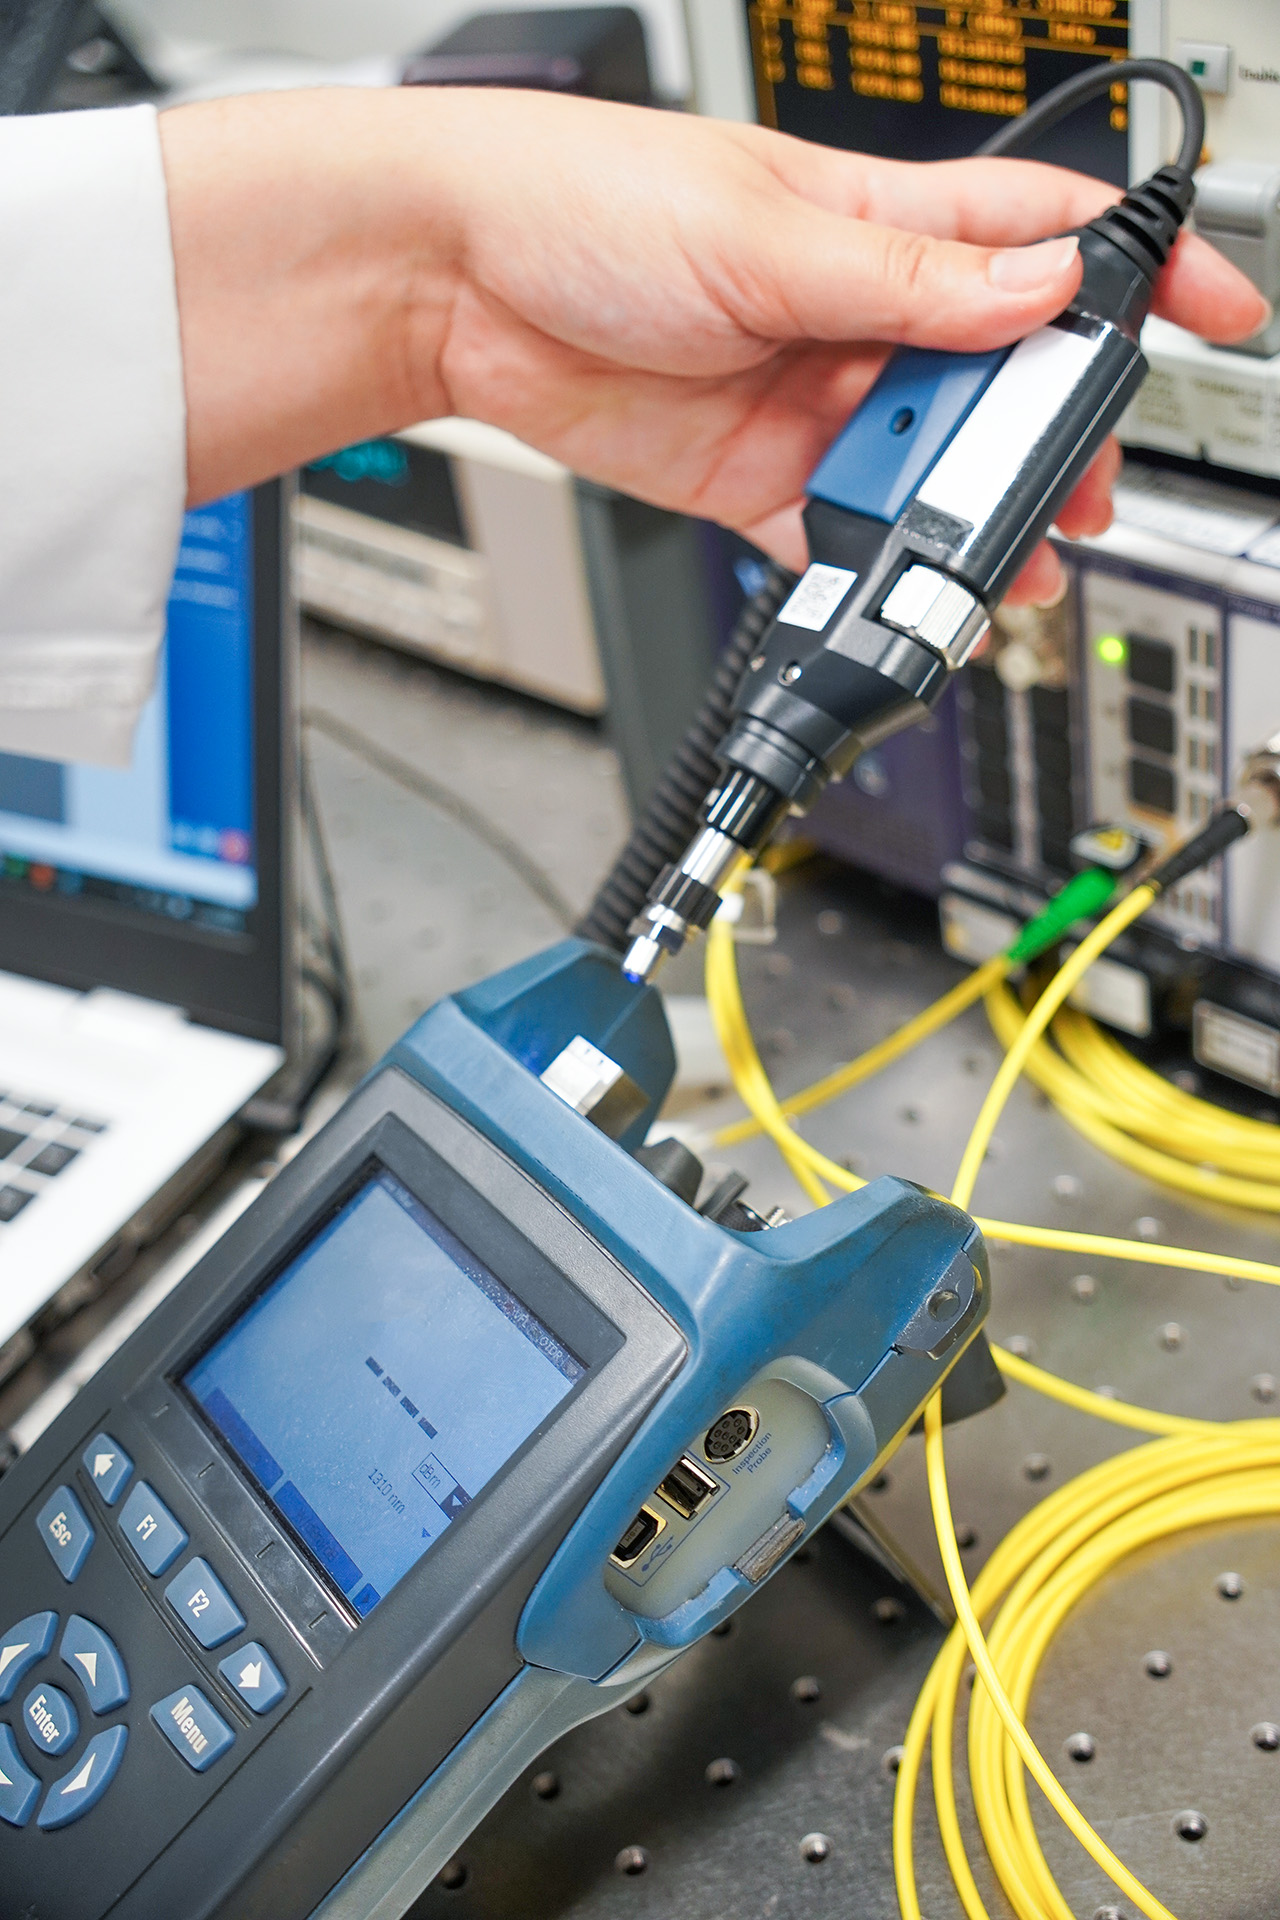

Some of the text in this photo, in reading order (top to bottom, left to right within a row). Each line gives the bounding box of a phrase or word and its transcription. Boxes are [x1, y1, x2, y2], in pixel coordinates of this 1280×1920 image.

[731, 1432, 772, 1475] Inspection
[747, 1447, 772, 1473] Probe
[368, 1468, 405, 1514] 1310 nm
[419, 1464, 441, 1489] dBm
[49, 1511, 72, 1546] Esc
[135, 1513, 158, 1541] F1
[187, 1588, 211, 1618] F2
[28, 1694, 60, 1744] Enter
[170, 1697, 208, 1754] Menu
